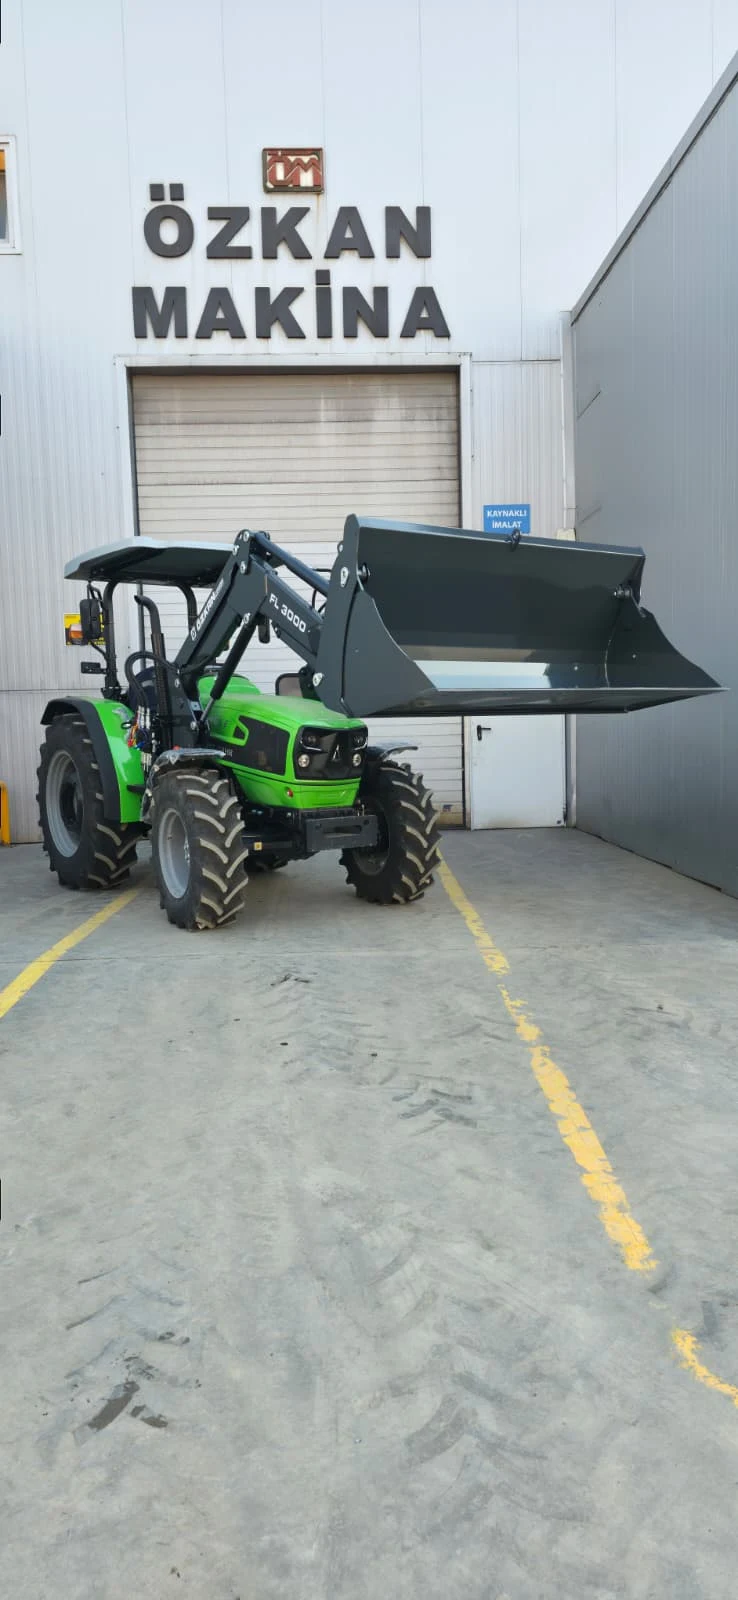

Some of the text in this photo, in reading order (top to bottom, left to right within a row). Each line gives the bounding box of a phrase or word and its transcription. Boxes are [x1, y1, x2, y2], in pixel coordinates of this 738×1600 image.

[143, 183, 432, 259] ÖZKAN
[131, 269, 451, 339] MAKİNA
[487, 509, 527, 518] KAYNAKLI
[492, 520, 522, 529] İMALAT
[269, 592, 307, 633] FL 3000
